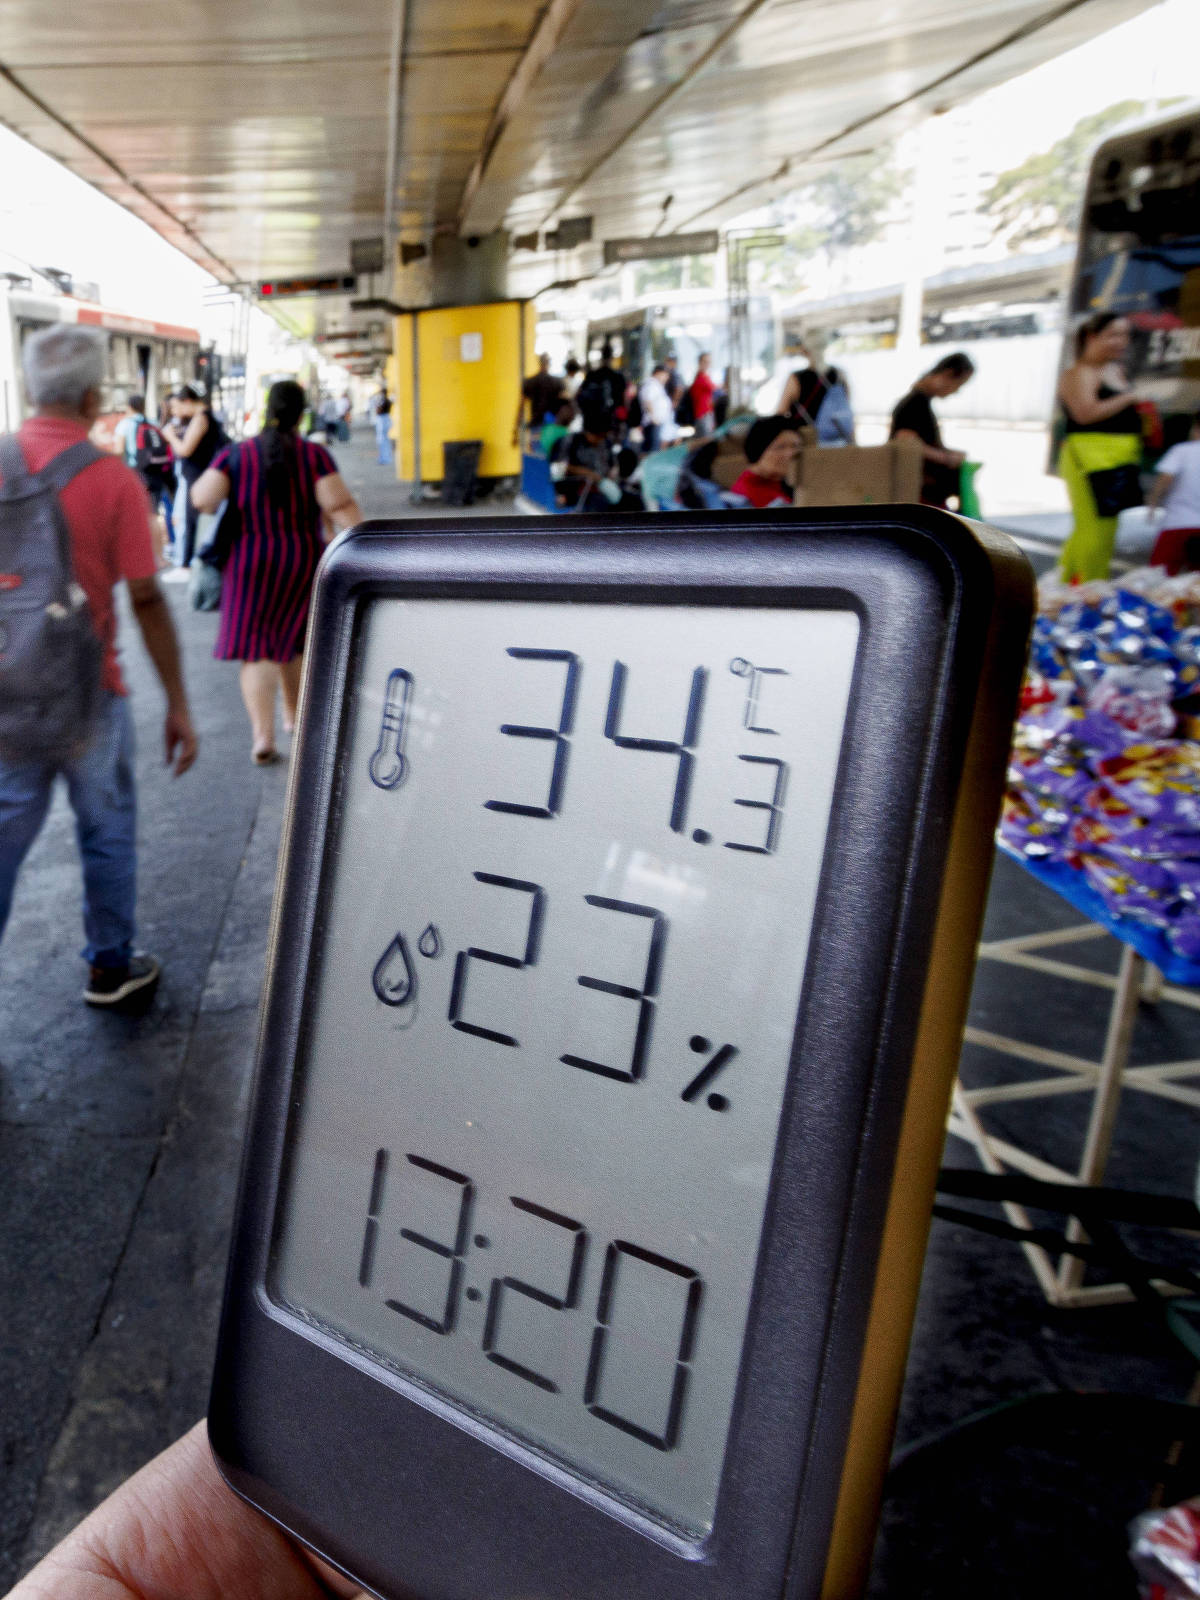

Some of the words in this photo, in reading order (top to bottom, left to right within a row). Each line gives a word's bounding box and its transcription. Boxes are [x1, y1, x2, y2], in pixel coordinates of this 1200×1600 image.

[448, 871, 668, 1083] 23
[681, 1034, 738, 1112] %
[359, 1147, 704, 1452] 13:20
